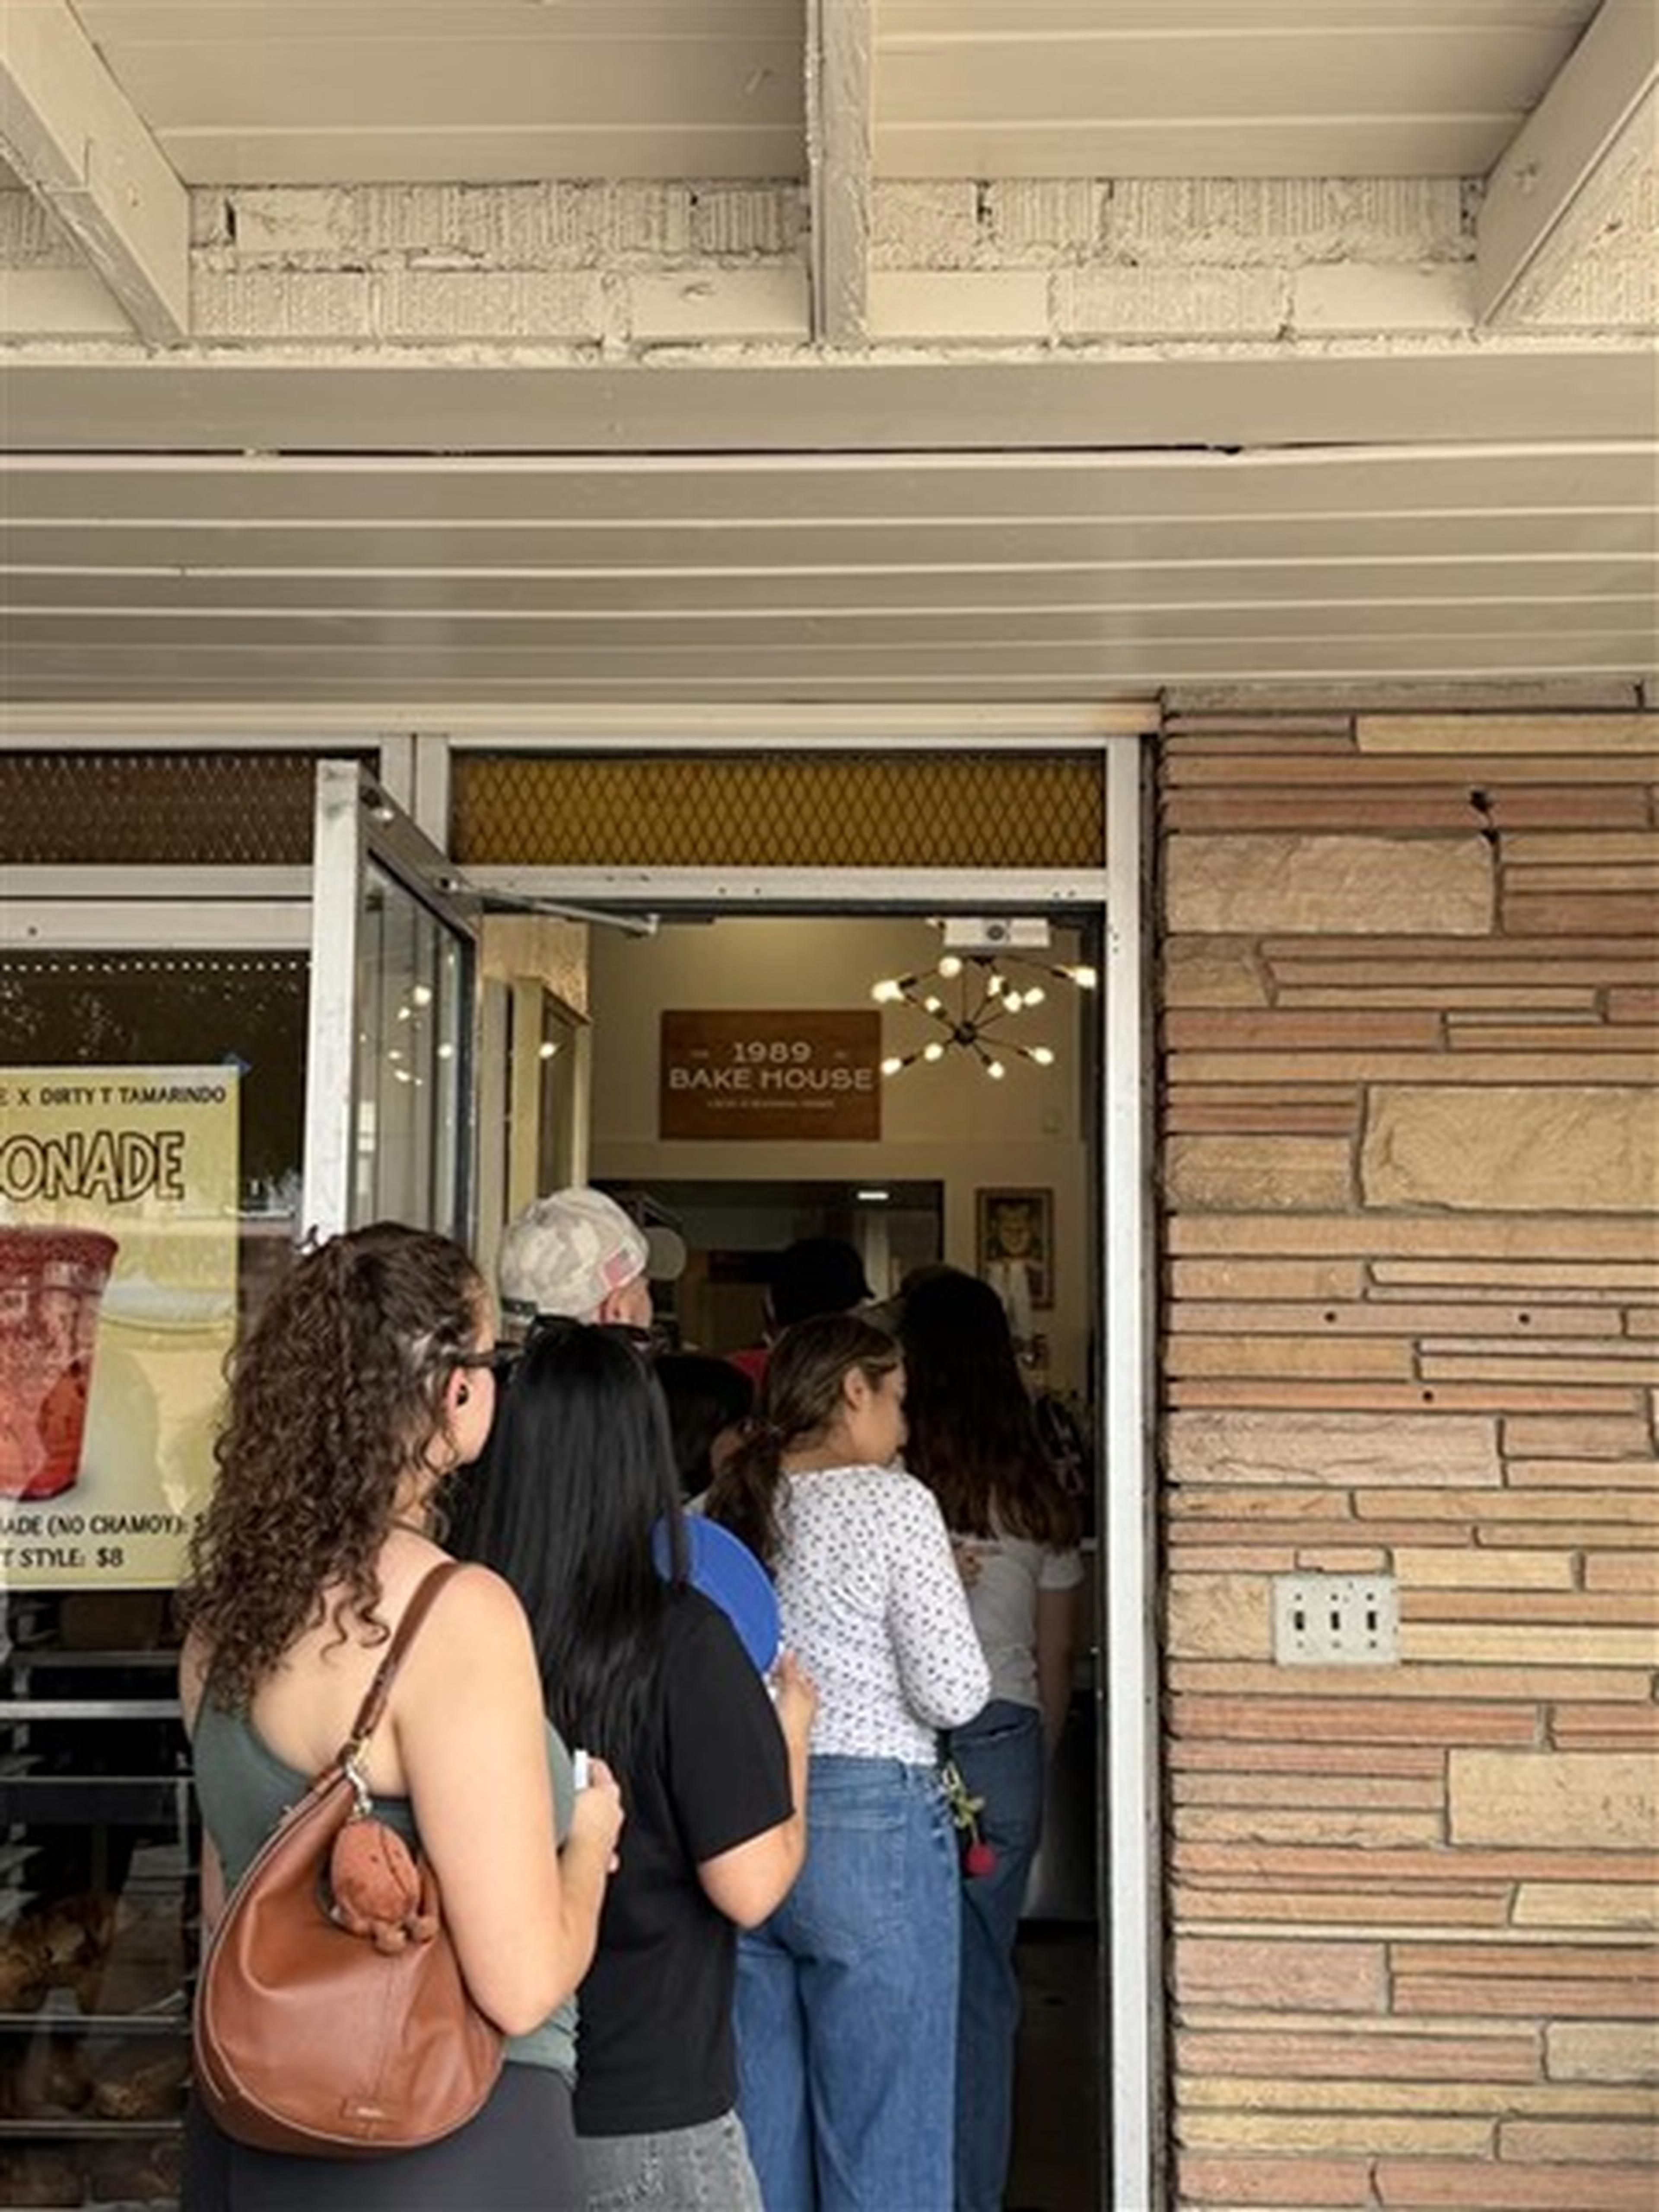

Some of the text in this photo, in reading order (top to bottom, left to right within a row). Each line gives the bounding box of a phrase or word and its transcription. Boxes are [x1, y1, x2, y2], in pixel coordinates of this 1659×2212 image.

[734, 1041, 811, 1063] 1989
[669, 1068, 873, 1090] BAKE HOUSE
[18, 1089, 30, 1105] X
[41, 1087, 96, 1105] DIRTY
[100, 1087, 113, 1103] T
[118, 1087, 226, 1104] TAMARINDO
[0, 1130, 185, 1204] ONADE
[48, 1515, 84, 1537] (NO
[21, 1548, 85, 1568] STYLE:
[96, 1545, 124, 1568] $8
